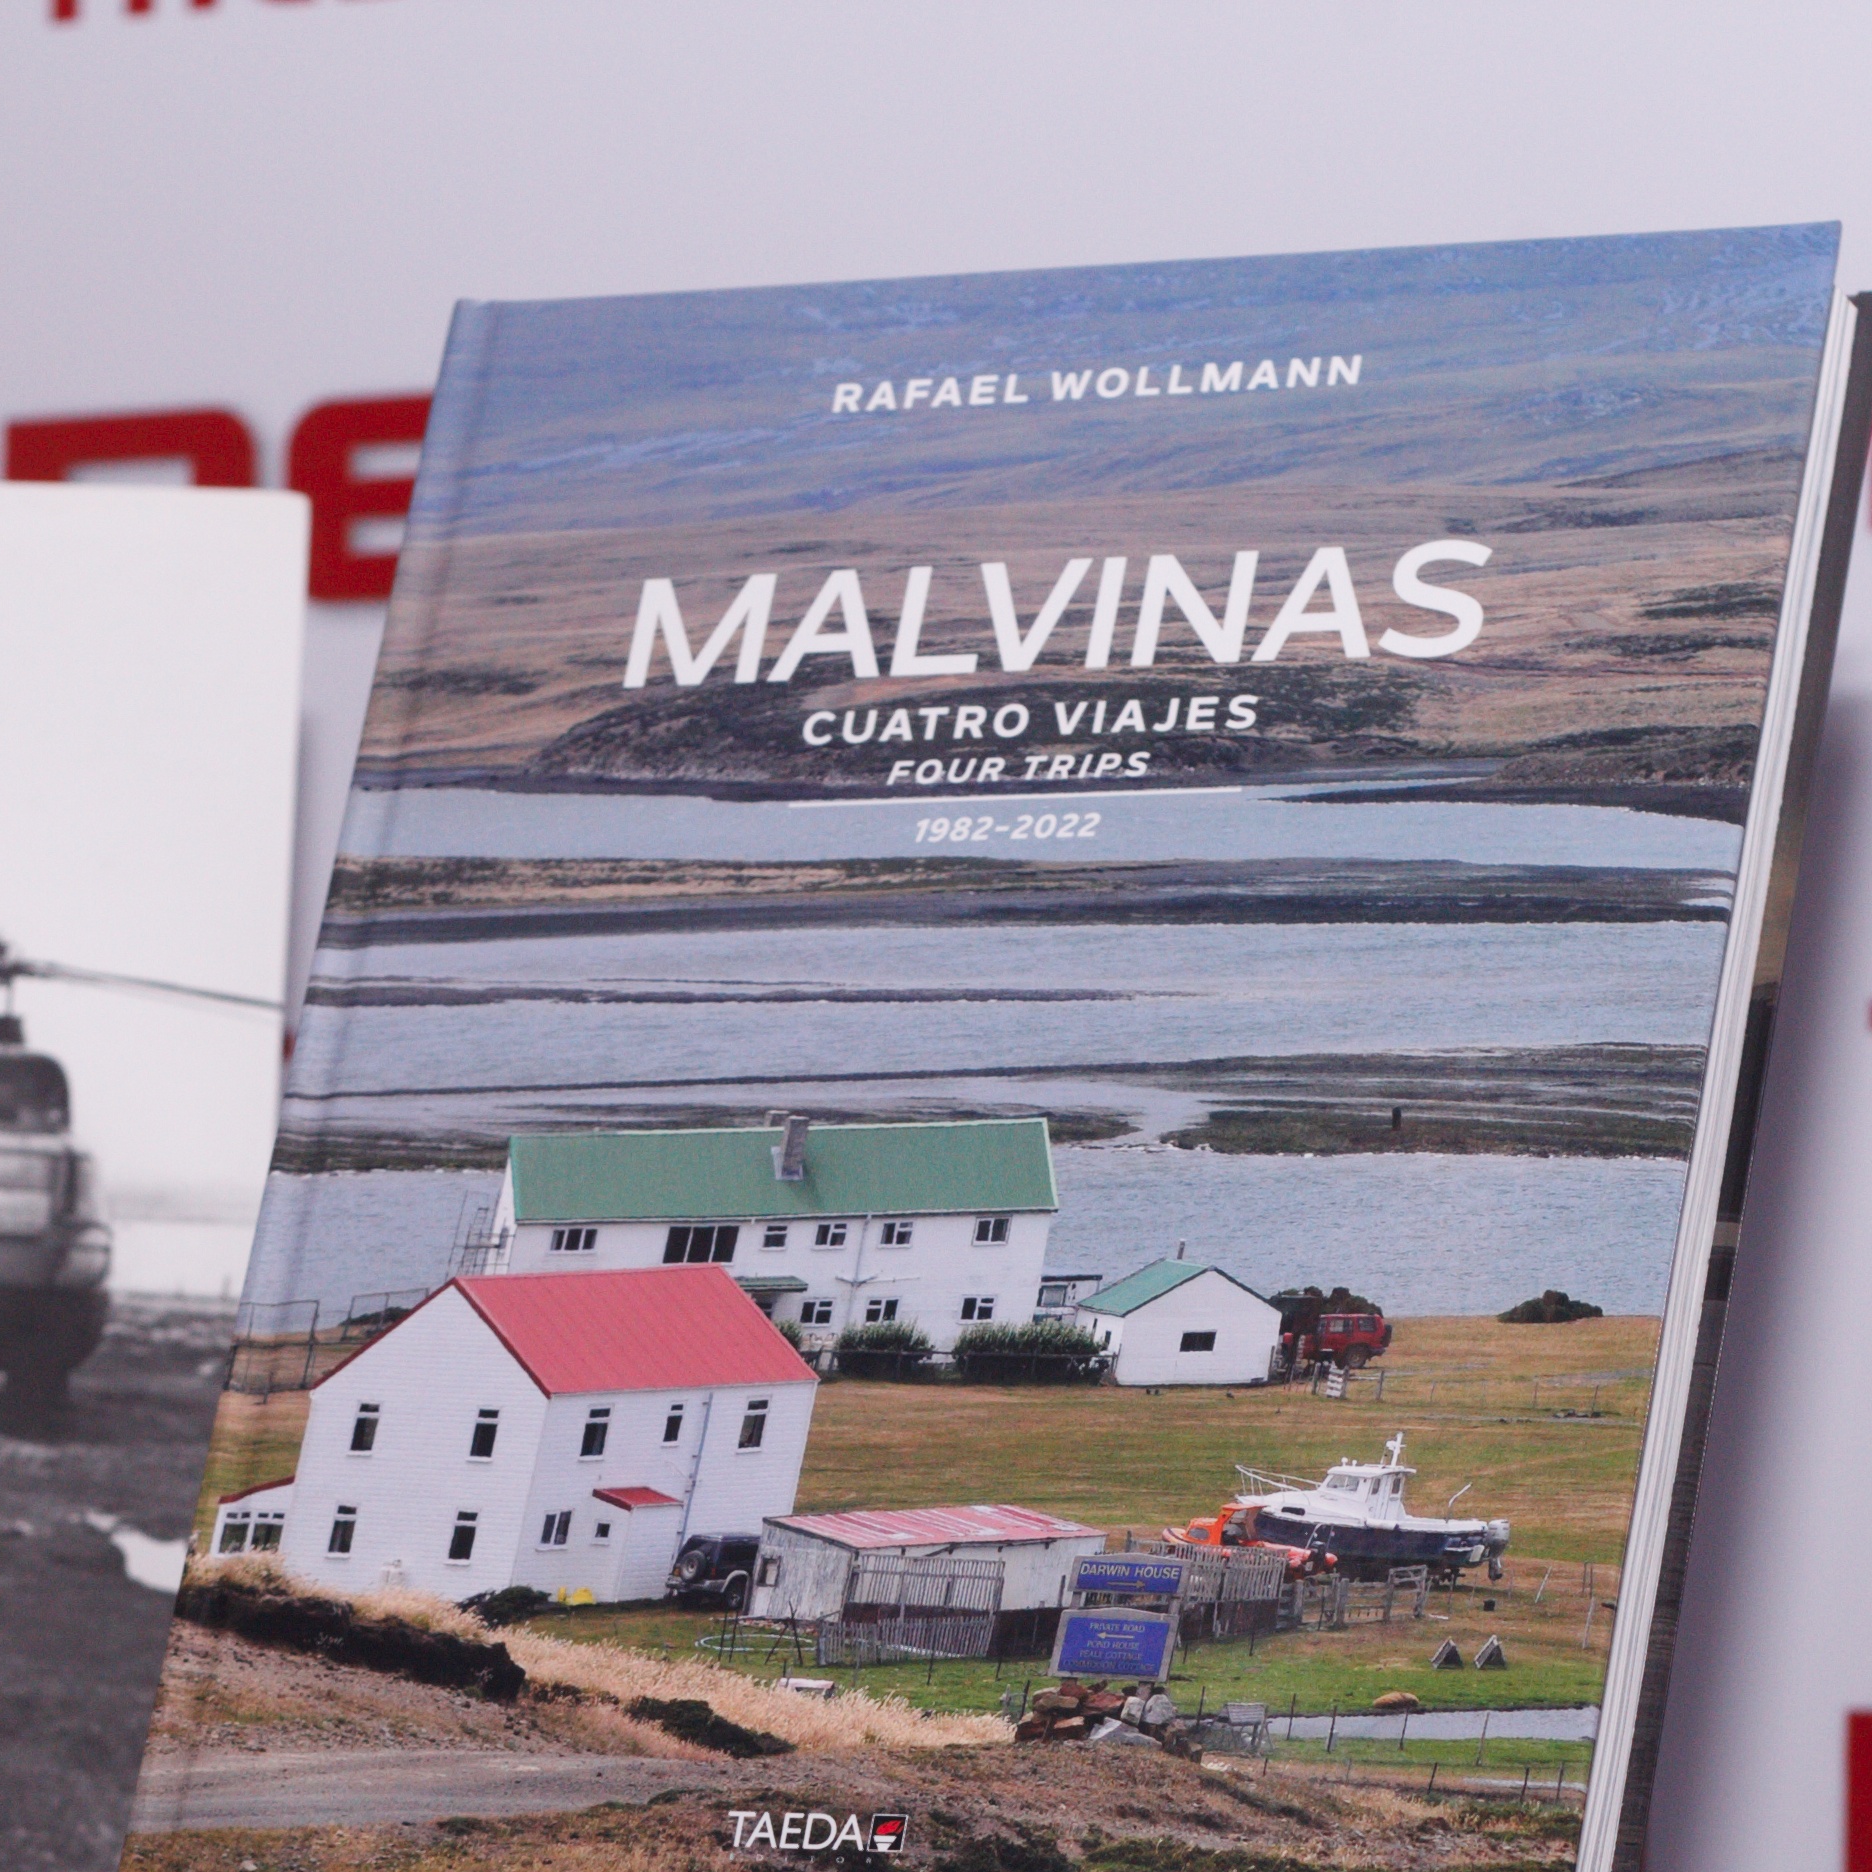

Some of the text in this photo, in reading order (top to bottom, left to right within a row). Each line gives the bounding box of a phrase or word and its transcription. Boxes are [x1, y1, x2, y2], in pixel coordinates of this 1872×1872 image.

[831, 354, 1364, 414] RAFAEL WOLLMANN
[621, 537, 1495, 690] MALVINAS
[800, 693, 1260, 747] CUATRO VIAJES
[885, 750, 1151, 788] FOUR TRIPS
[913, 811, 1102, 844] 1982-2022
[1080, 1563, 1180, 1579] DARWIN HOUSE
[728, 1810, 865, 1852] TAEDA
